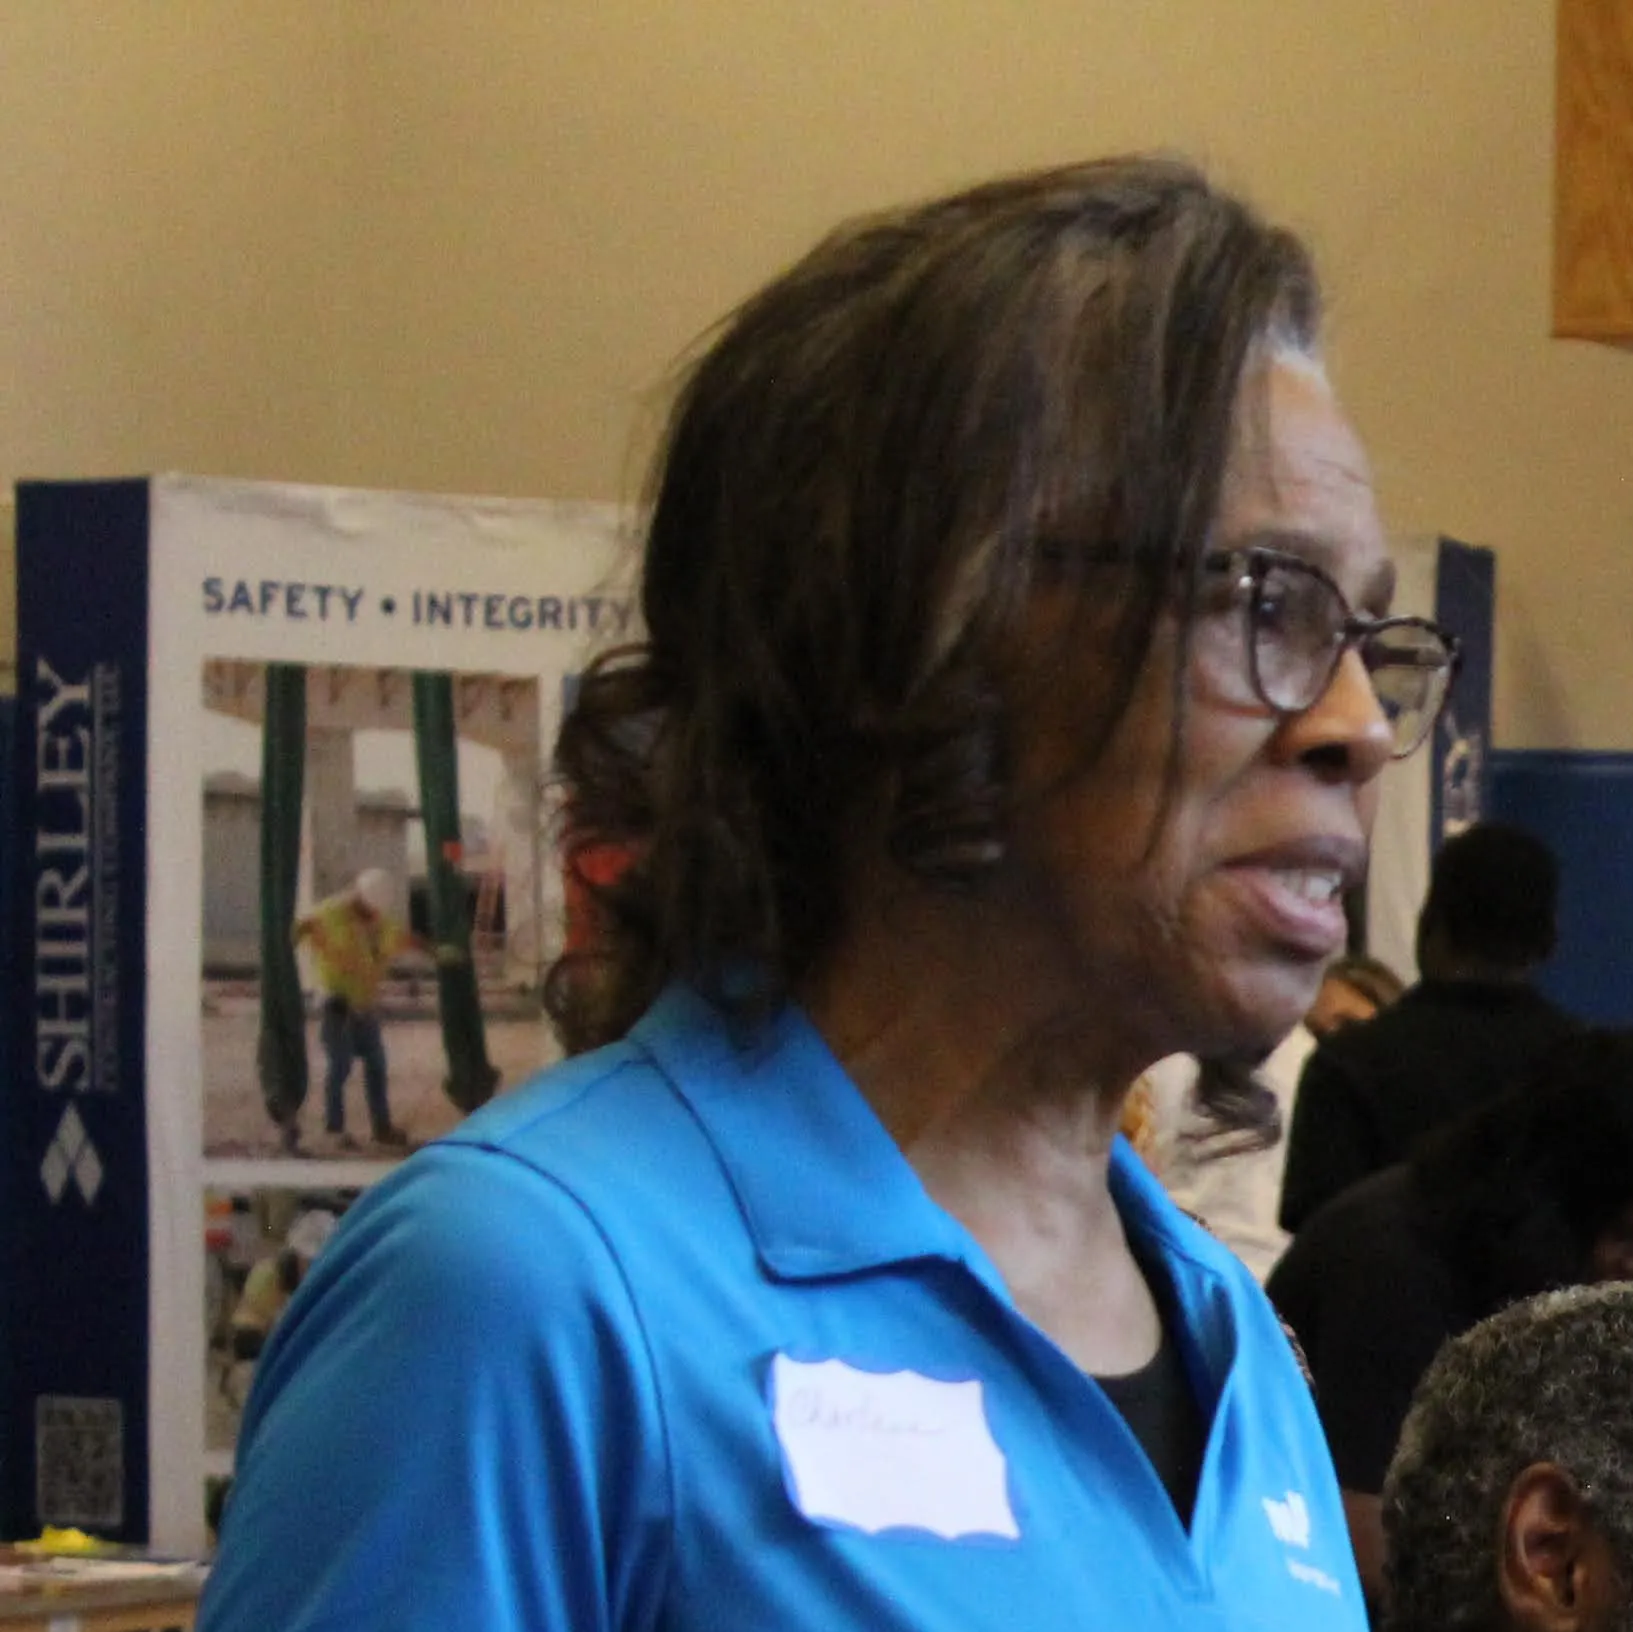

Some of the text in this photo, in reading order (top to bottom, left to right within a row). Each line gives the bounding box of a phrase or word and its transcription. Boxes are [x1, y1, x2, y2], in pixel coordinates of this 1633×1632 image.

[201, 577, 637, 632] SAFETY INTEGRITY
[36, 655, 92, 1091] SHIRLEY
